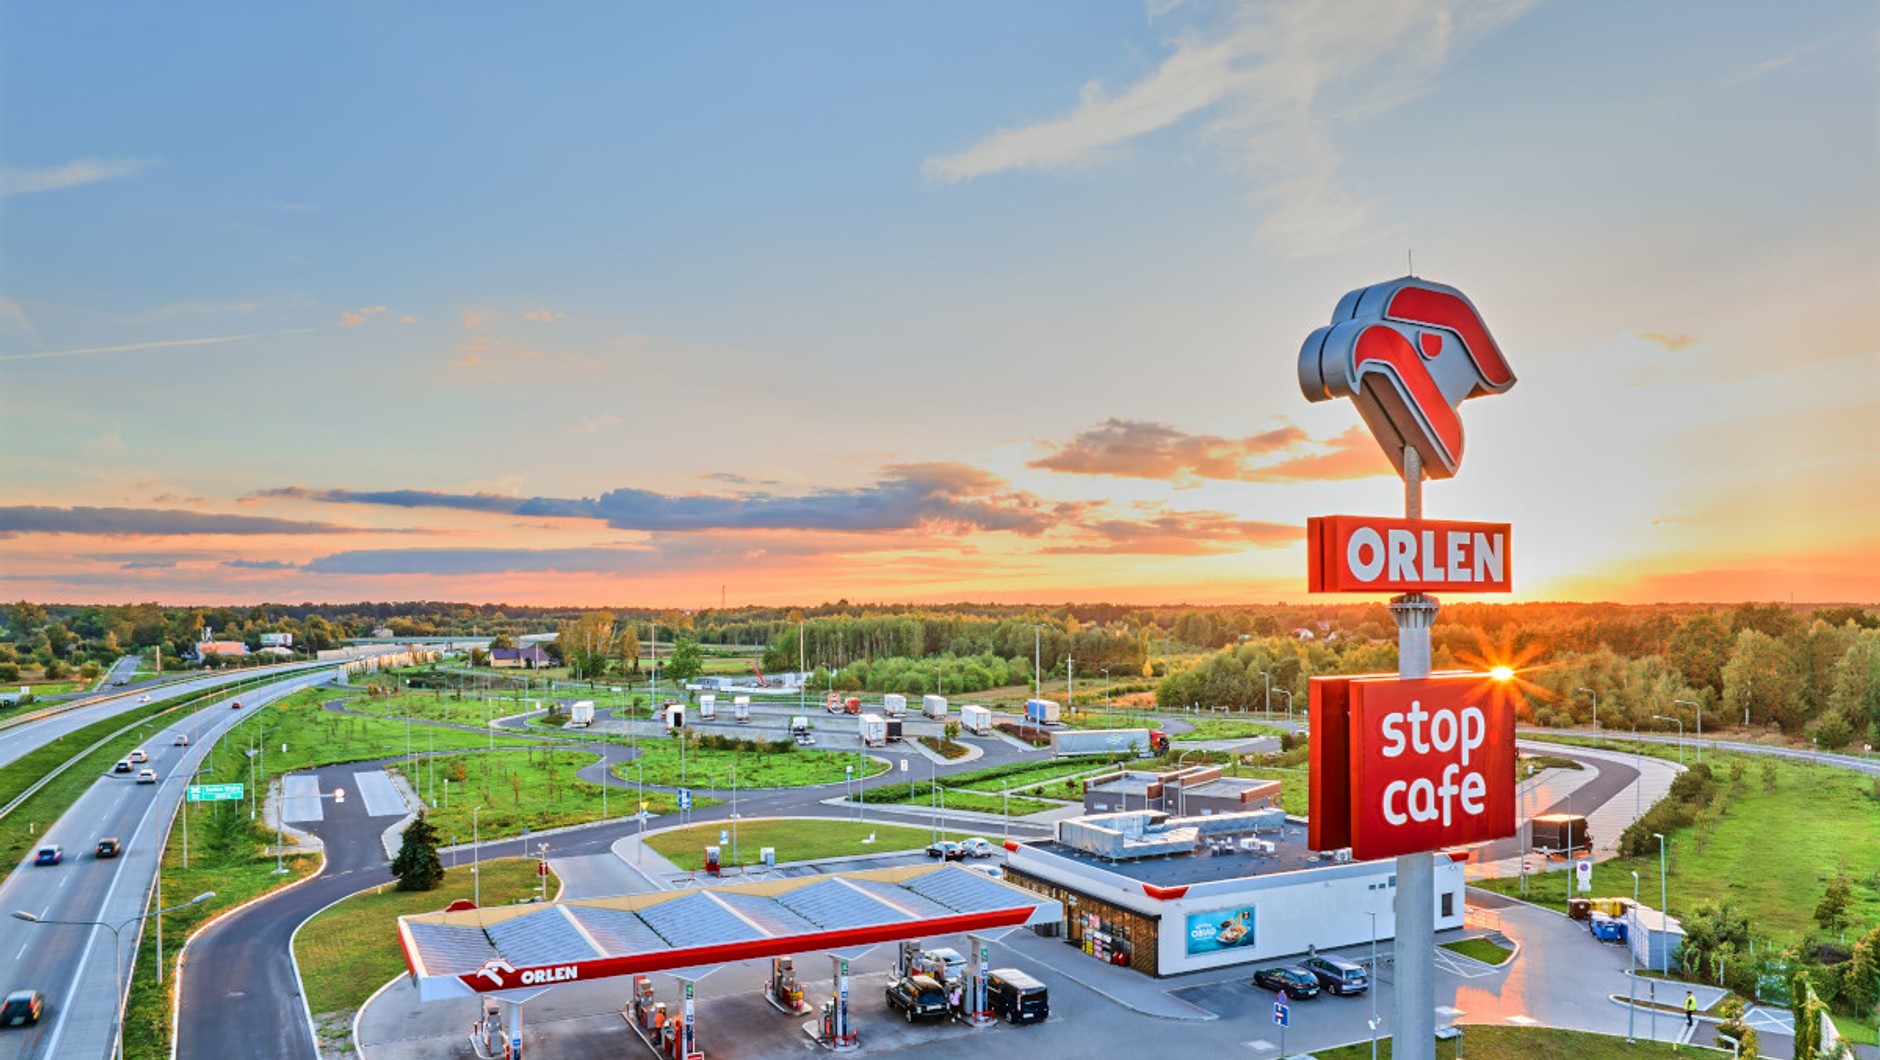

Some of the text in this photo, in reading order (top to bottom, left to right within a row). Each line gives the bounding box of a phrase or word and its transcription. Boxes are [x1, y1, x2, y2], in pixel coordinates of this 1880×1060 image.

[1347, 527, 1504, 582] ORLEN
[1381, 700, 1486, 767] stop
[1382, 763, 1487, 827] cafe
[521, 965, 578, 985] ORLEN
